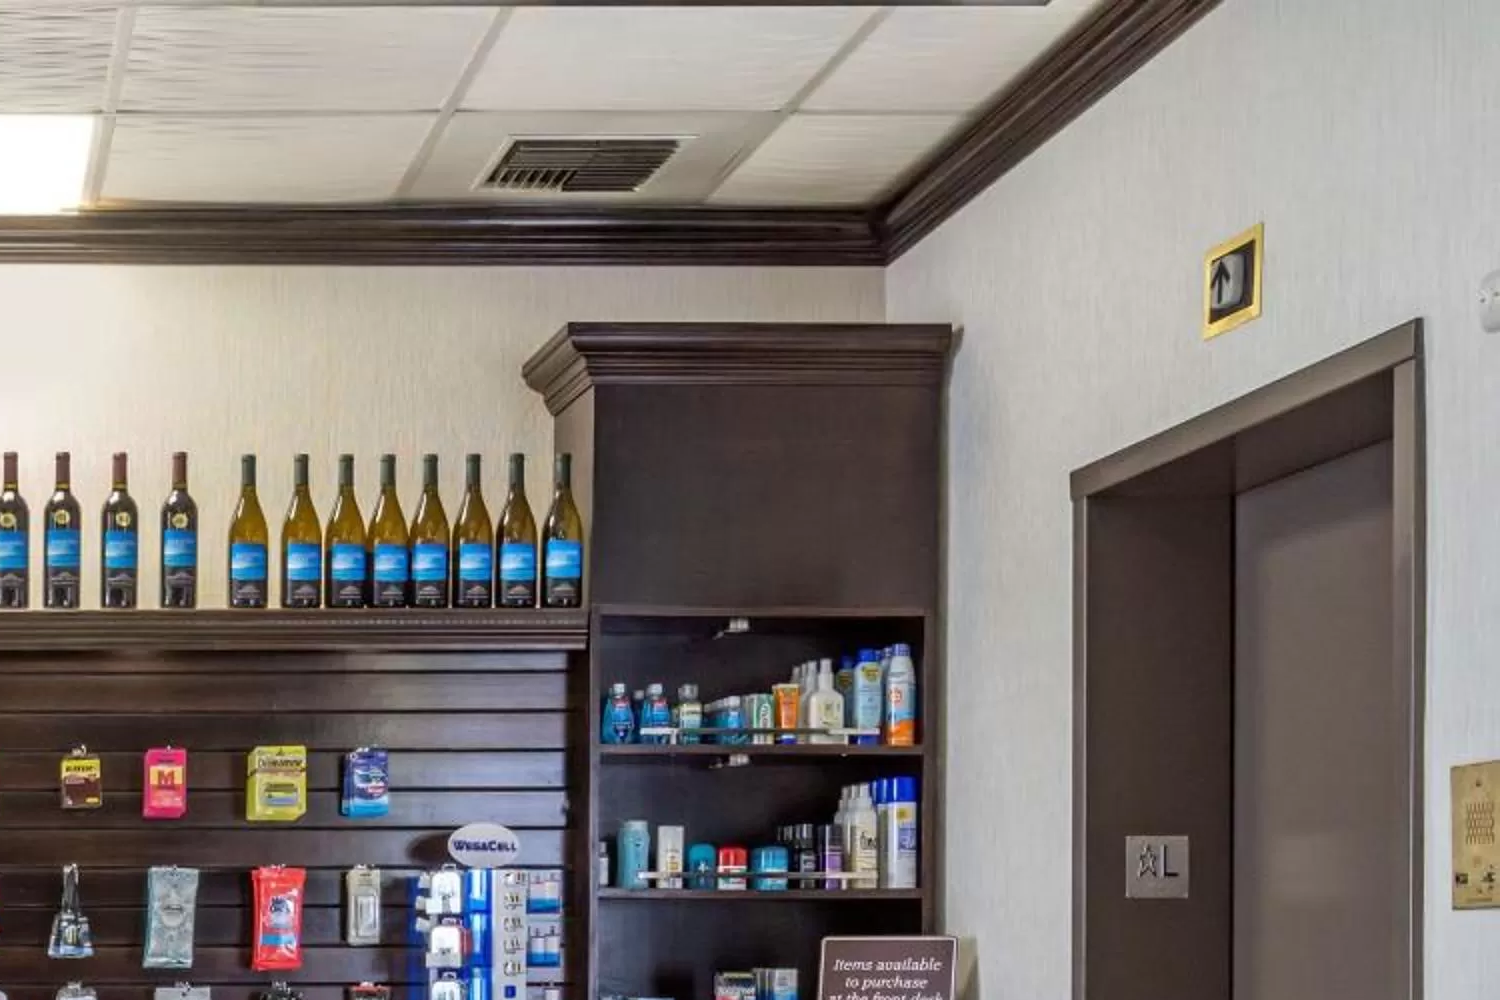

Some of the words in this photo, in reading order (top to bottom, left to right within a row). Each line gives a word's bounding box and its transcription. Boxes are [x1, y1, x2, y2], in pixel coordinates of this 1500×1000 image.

[1160, 843, 1180, 878] L
[833, 958, 873, 972] Items
[876, 957, 943, 972] available
[845, 976, 859, 989] to
[861, 975, 929, 991] purchase
